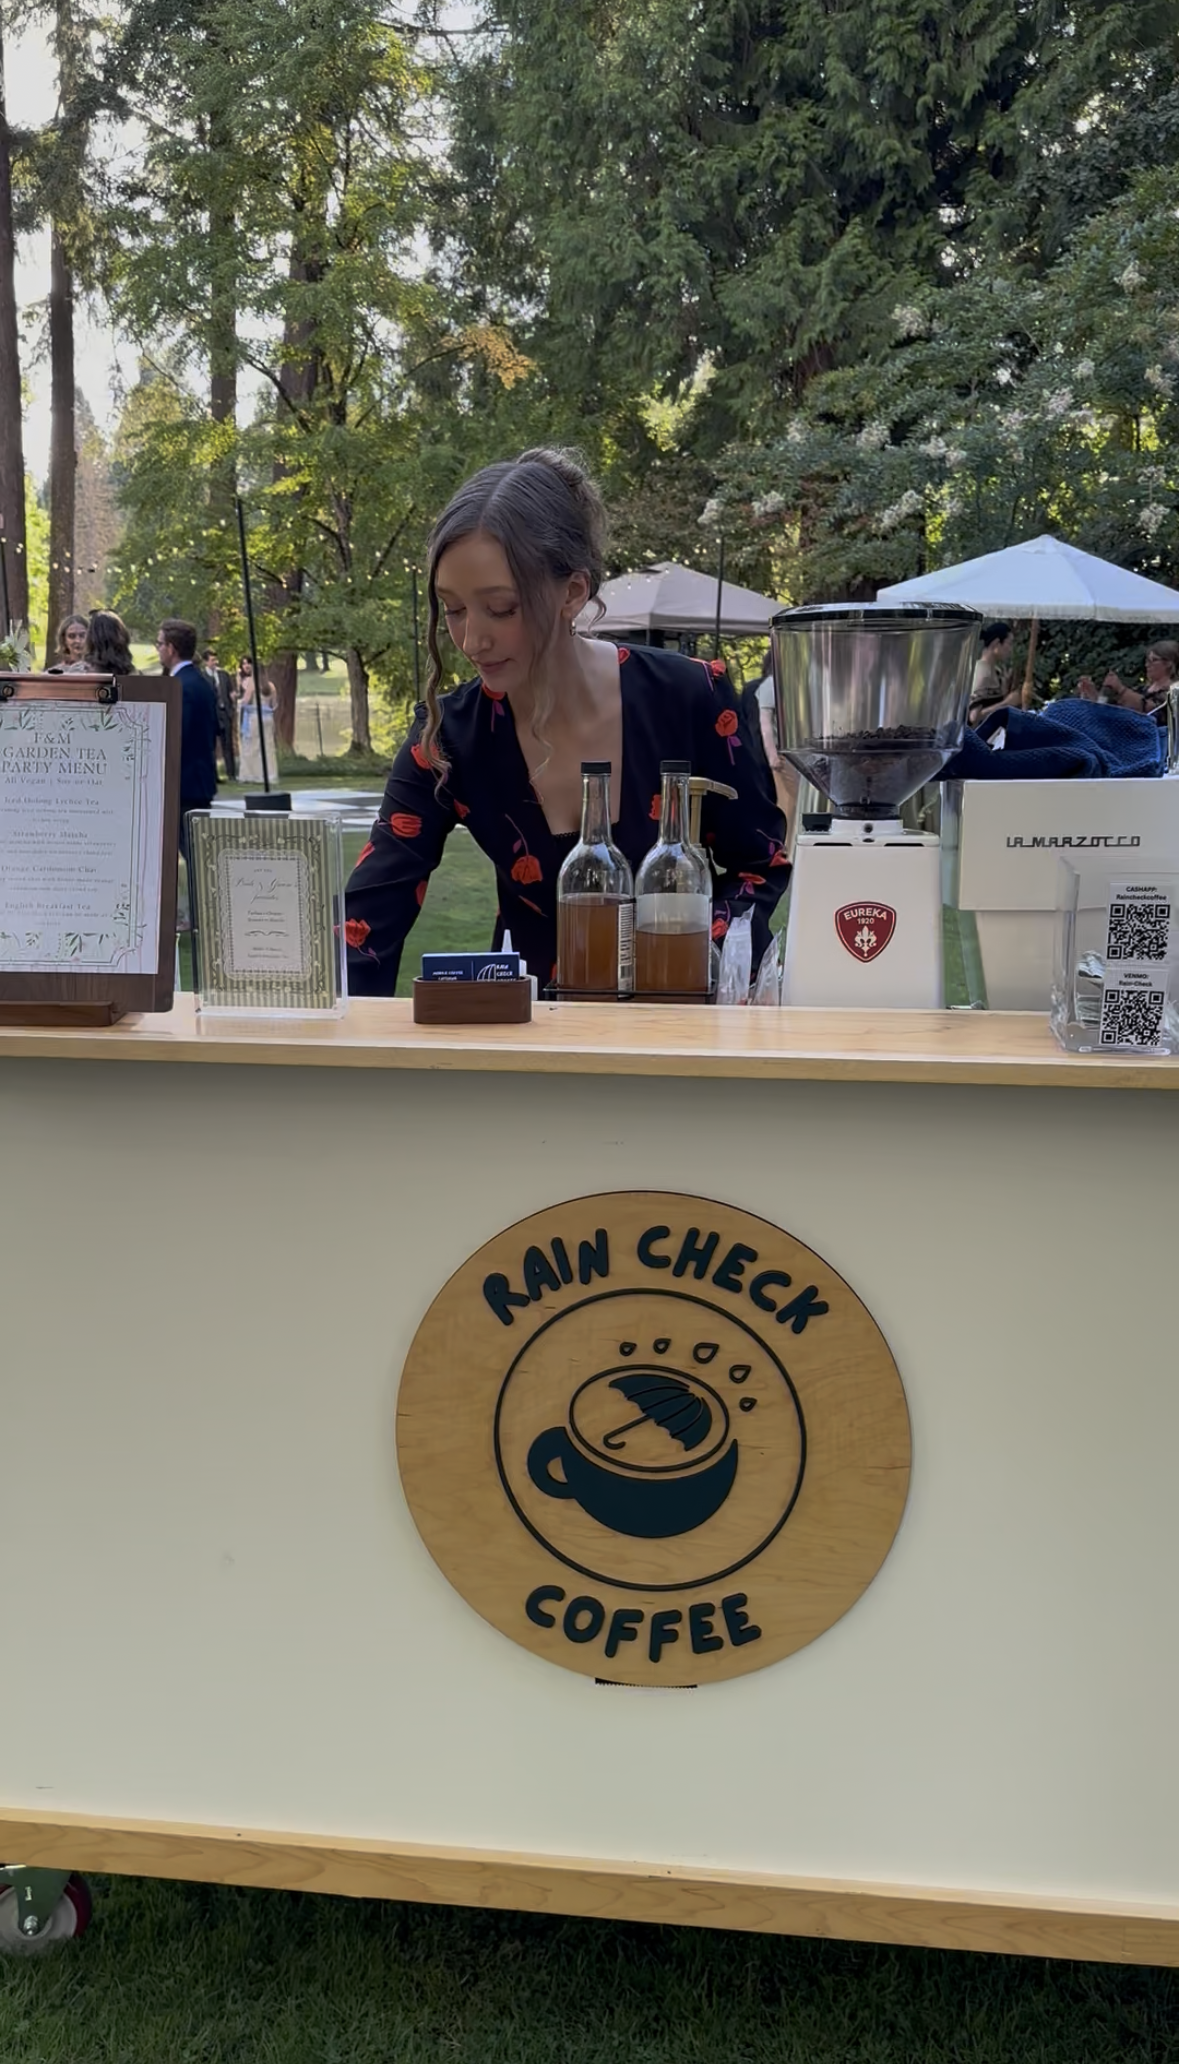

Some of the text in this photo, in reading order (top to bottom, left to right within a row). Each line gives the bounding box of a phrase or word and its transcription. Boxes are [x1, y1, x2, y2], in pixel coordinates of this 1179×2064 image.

[34, 732, 71, 744] F&M
[3, 746, 107, 760] GARDEN TEA
[2, 760, 107, 775] PARTY MENU
[20, 776, 46, 785] Vegan
[1006, 836, 1023, 848] LA
[843, 907, 888, 921] EUREKA
[857, 917, 875, 925] 1920
[483, 1225, 829, 1334] RAIN CHECK
[525, 1585, 762, 1663] COFFEE
